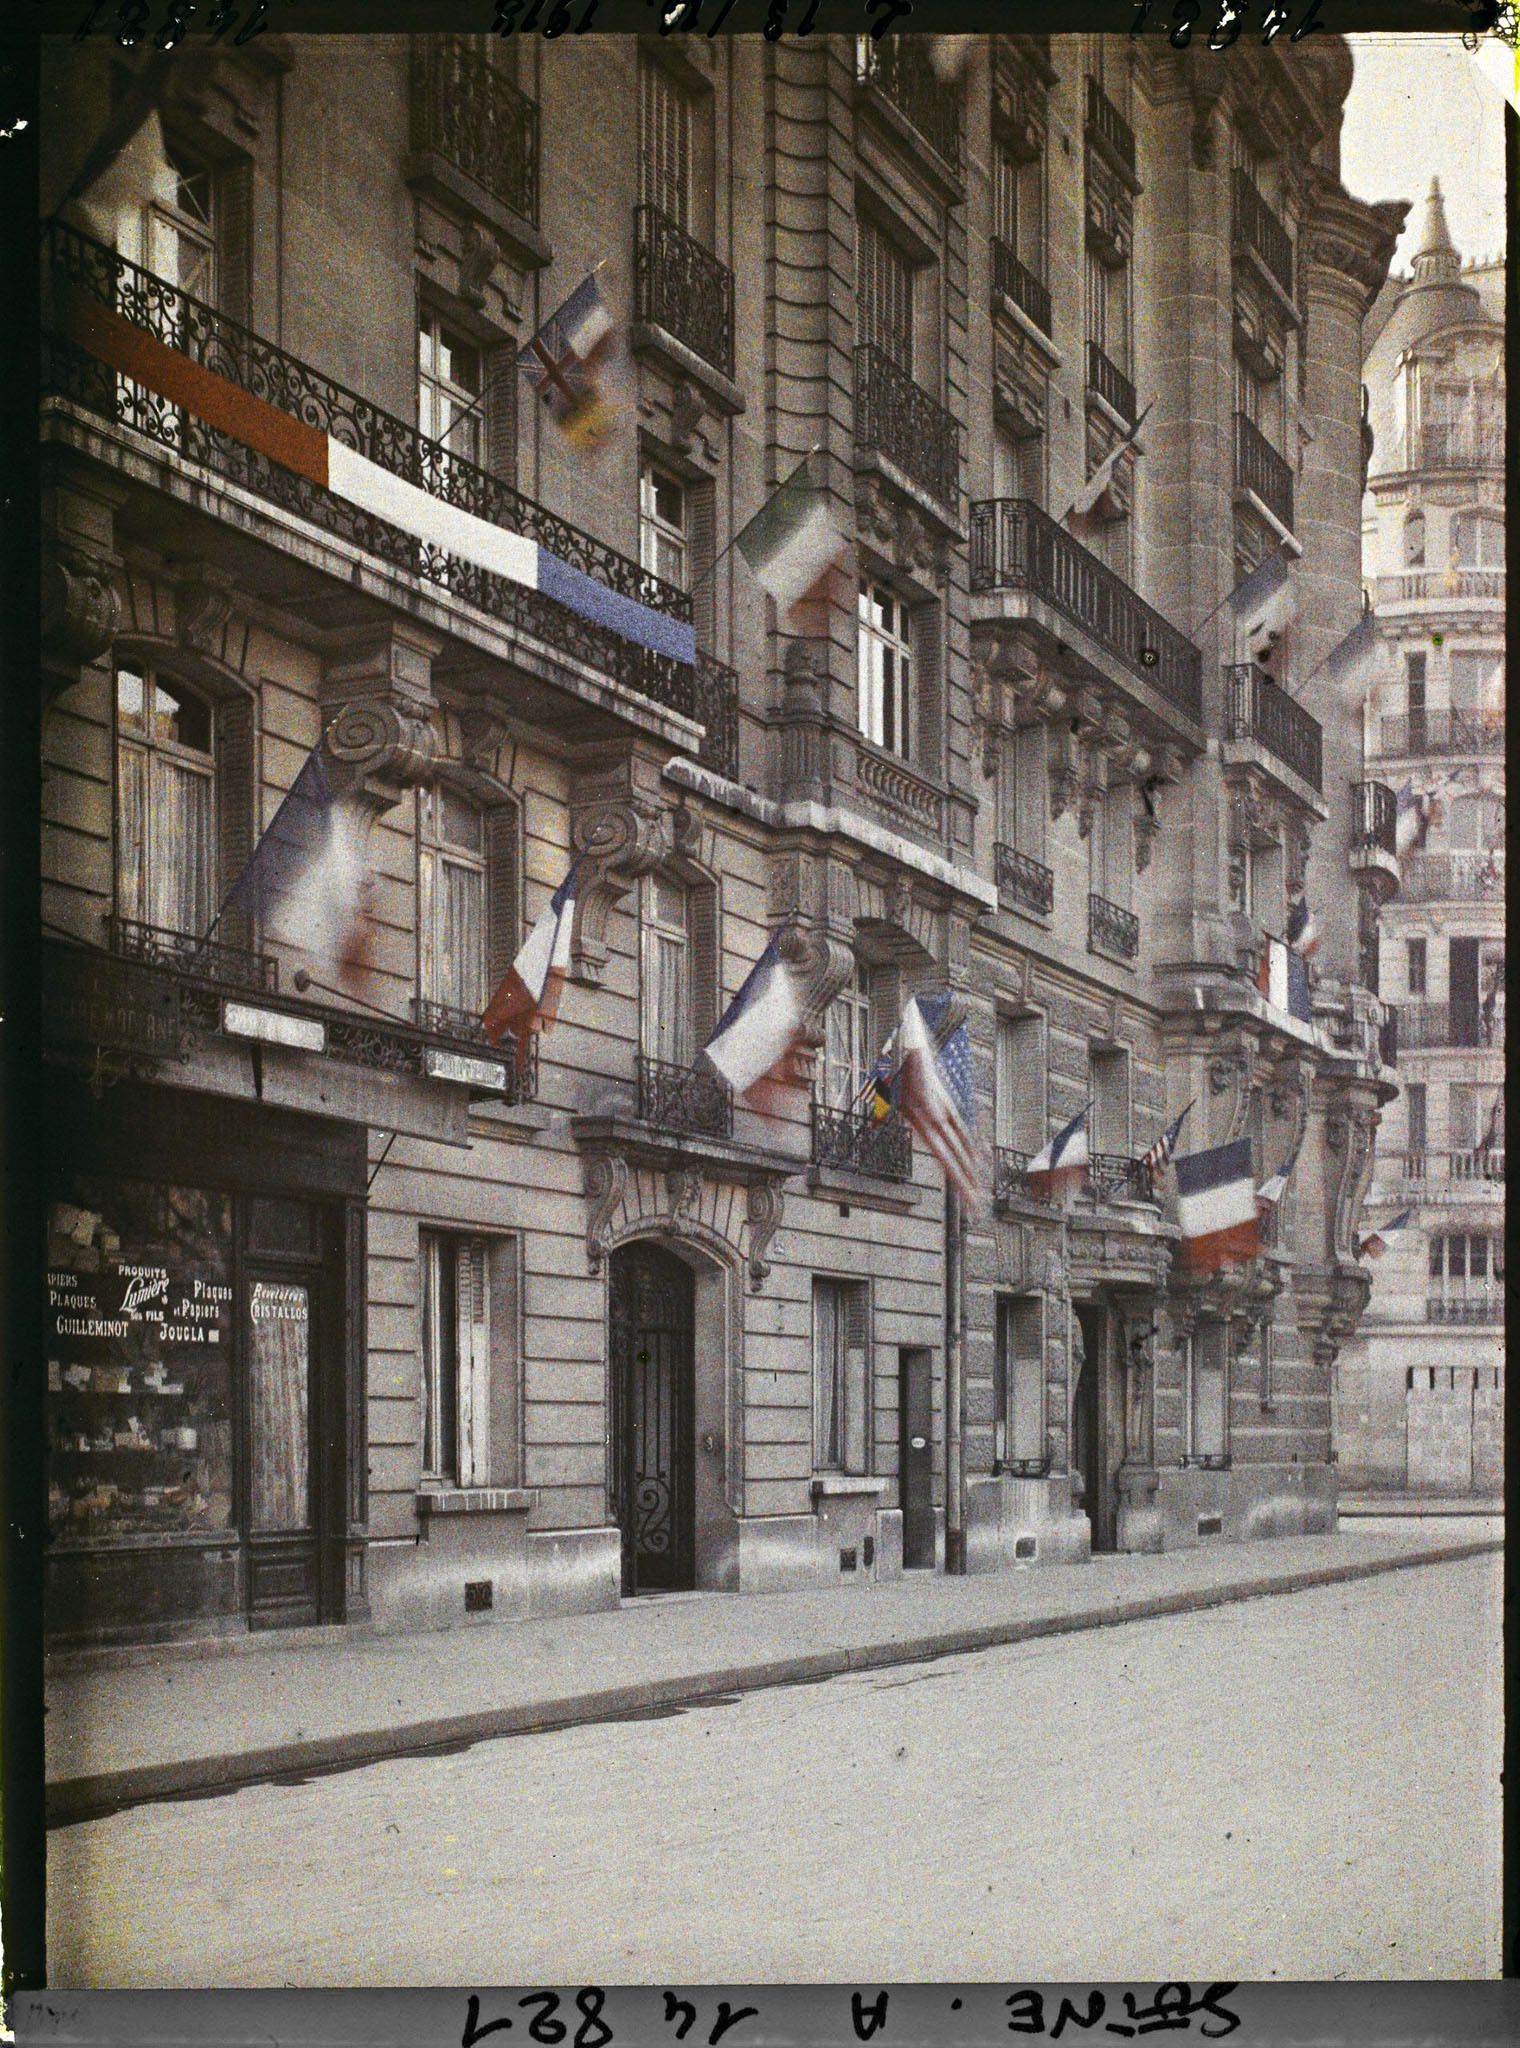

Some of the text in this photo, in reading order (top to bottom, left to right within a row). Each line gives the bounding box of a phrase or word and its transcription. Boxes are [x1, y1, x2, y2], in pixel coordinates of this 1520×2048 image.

[118, 1264, 167, 1279] PRODUITS
[50, 1290, 97, 1310] PLAQUES
[119, 1276, 169, 1313] Lumière
[193, 1279, 232, 1304] Plaques
[182, 1298, 219, 1323] Papiers
[250, 1297, 308, 1324] CRISTALLOS
[56, 1315, 129, 1338] GUILLEMINOT
[159, 1322, 204, 1343] JOUCLA
[460, 1986, 614, 2048] 821
[663, 1990, 762, 2047] 14
[851, 1992, 889, 2040] A
